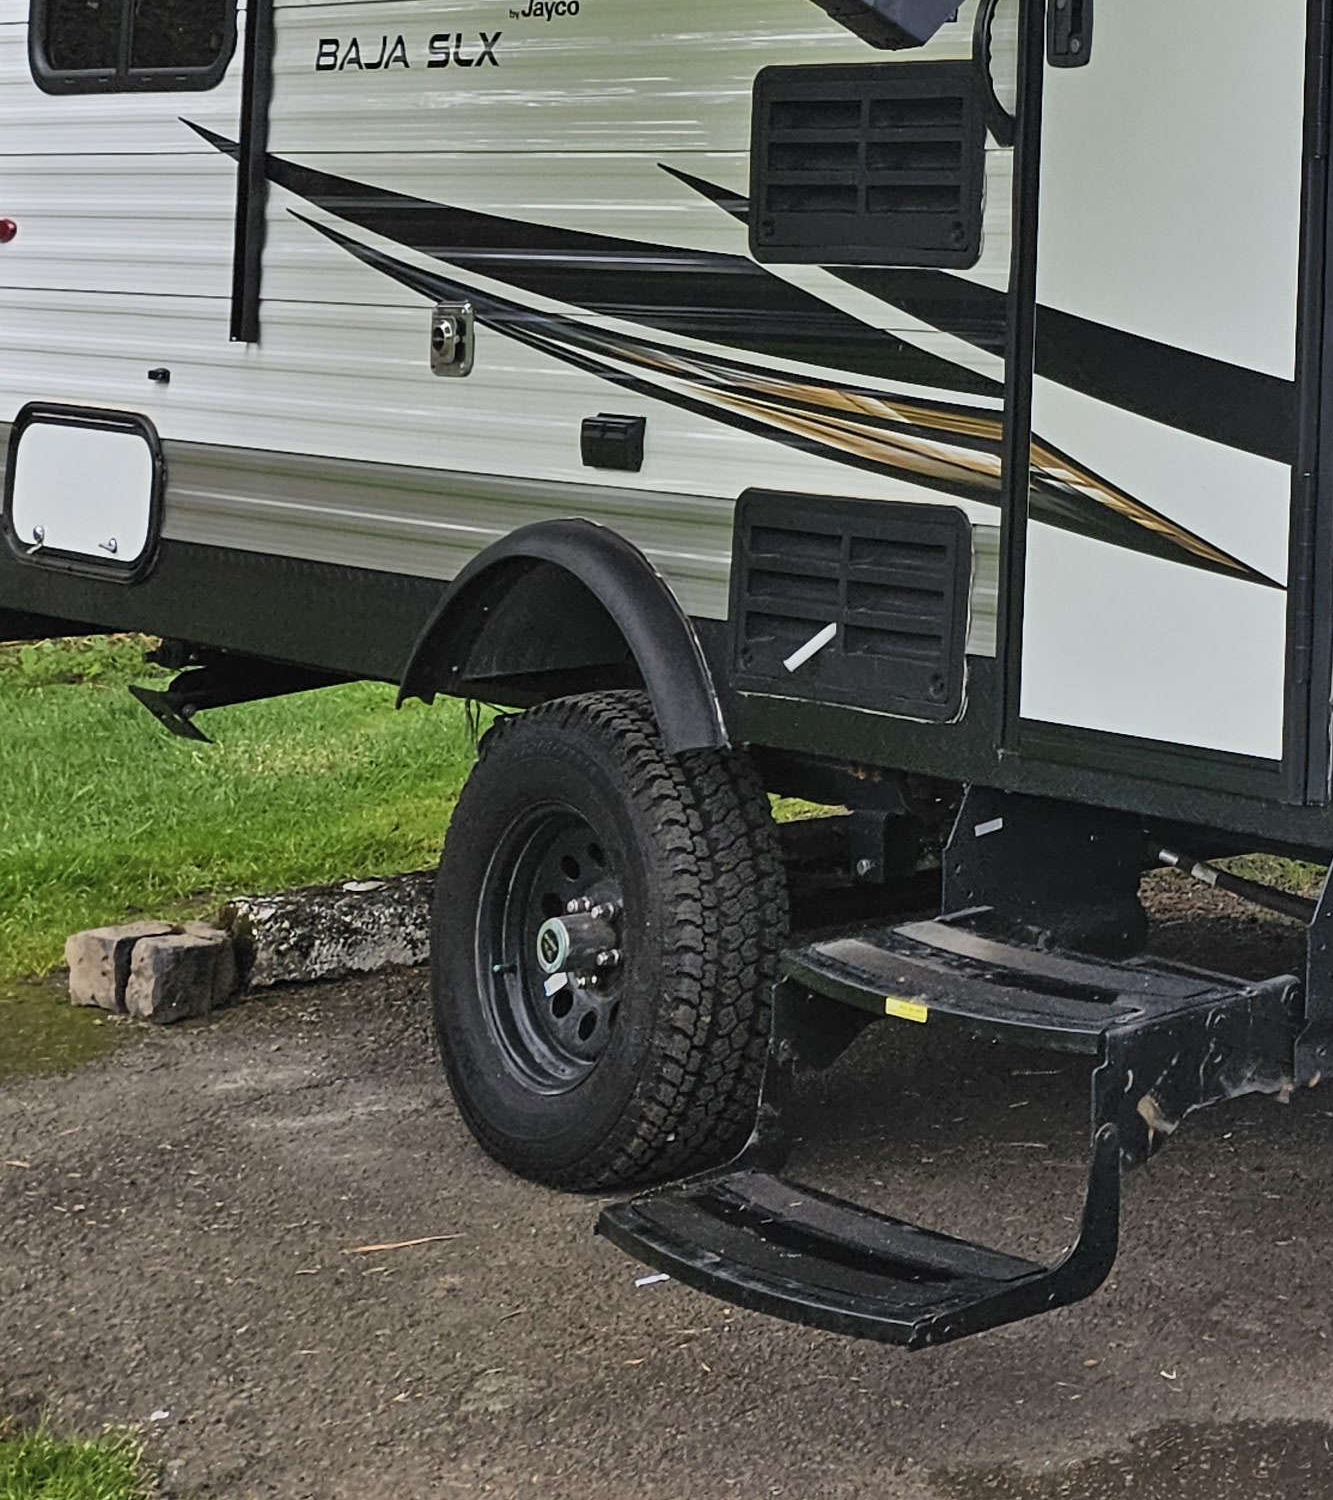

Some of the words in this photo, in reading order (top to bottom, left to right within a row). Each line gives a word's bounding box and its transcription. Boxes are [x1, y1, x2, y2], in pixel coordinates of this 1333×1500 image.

[509, 8, 520, 19] by
[315, 35, 410, 71] BAJA
[426, 31, 502, 68] SLX
